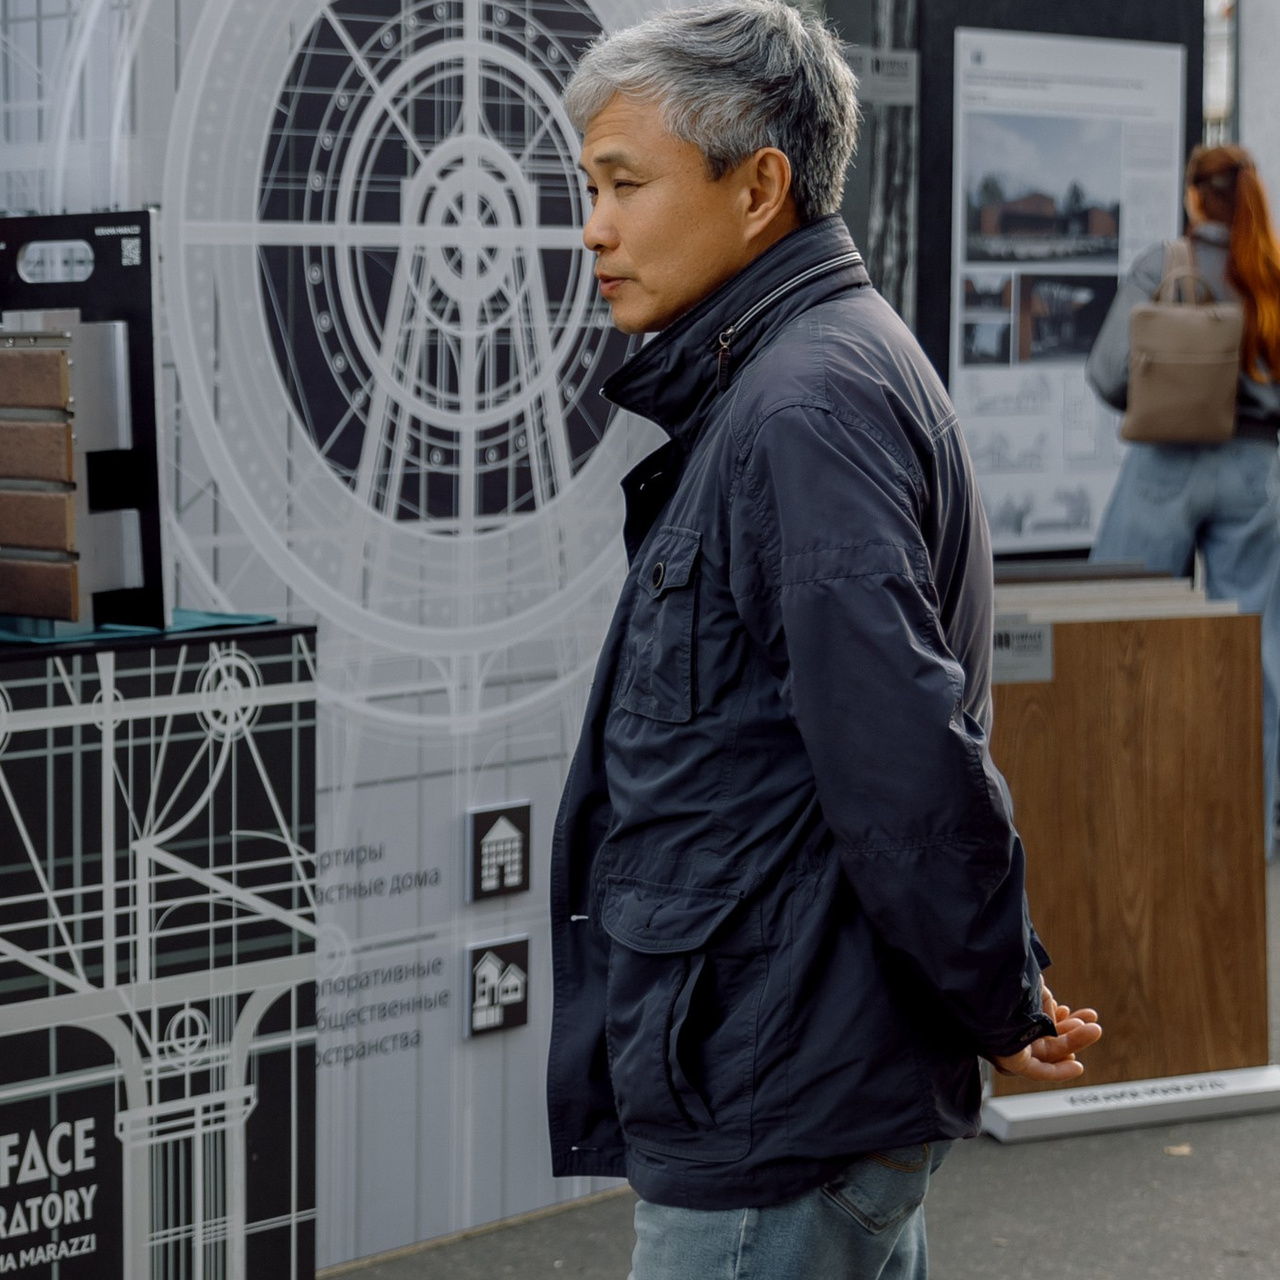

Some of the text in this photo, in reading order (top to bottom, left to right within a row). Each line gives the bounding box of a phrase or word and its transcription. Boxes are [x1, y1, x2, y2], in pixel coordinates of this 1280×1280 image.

[316, 842, 384, 875] ртиры
[389, 867, 442, 896] дома
[315, 957, 443, 998] поративные
[316, 989, 450, 1033] бщественные
[20, 1233, 96, 1269] MARAZZI
